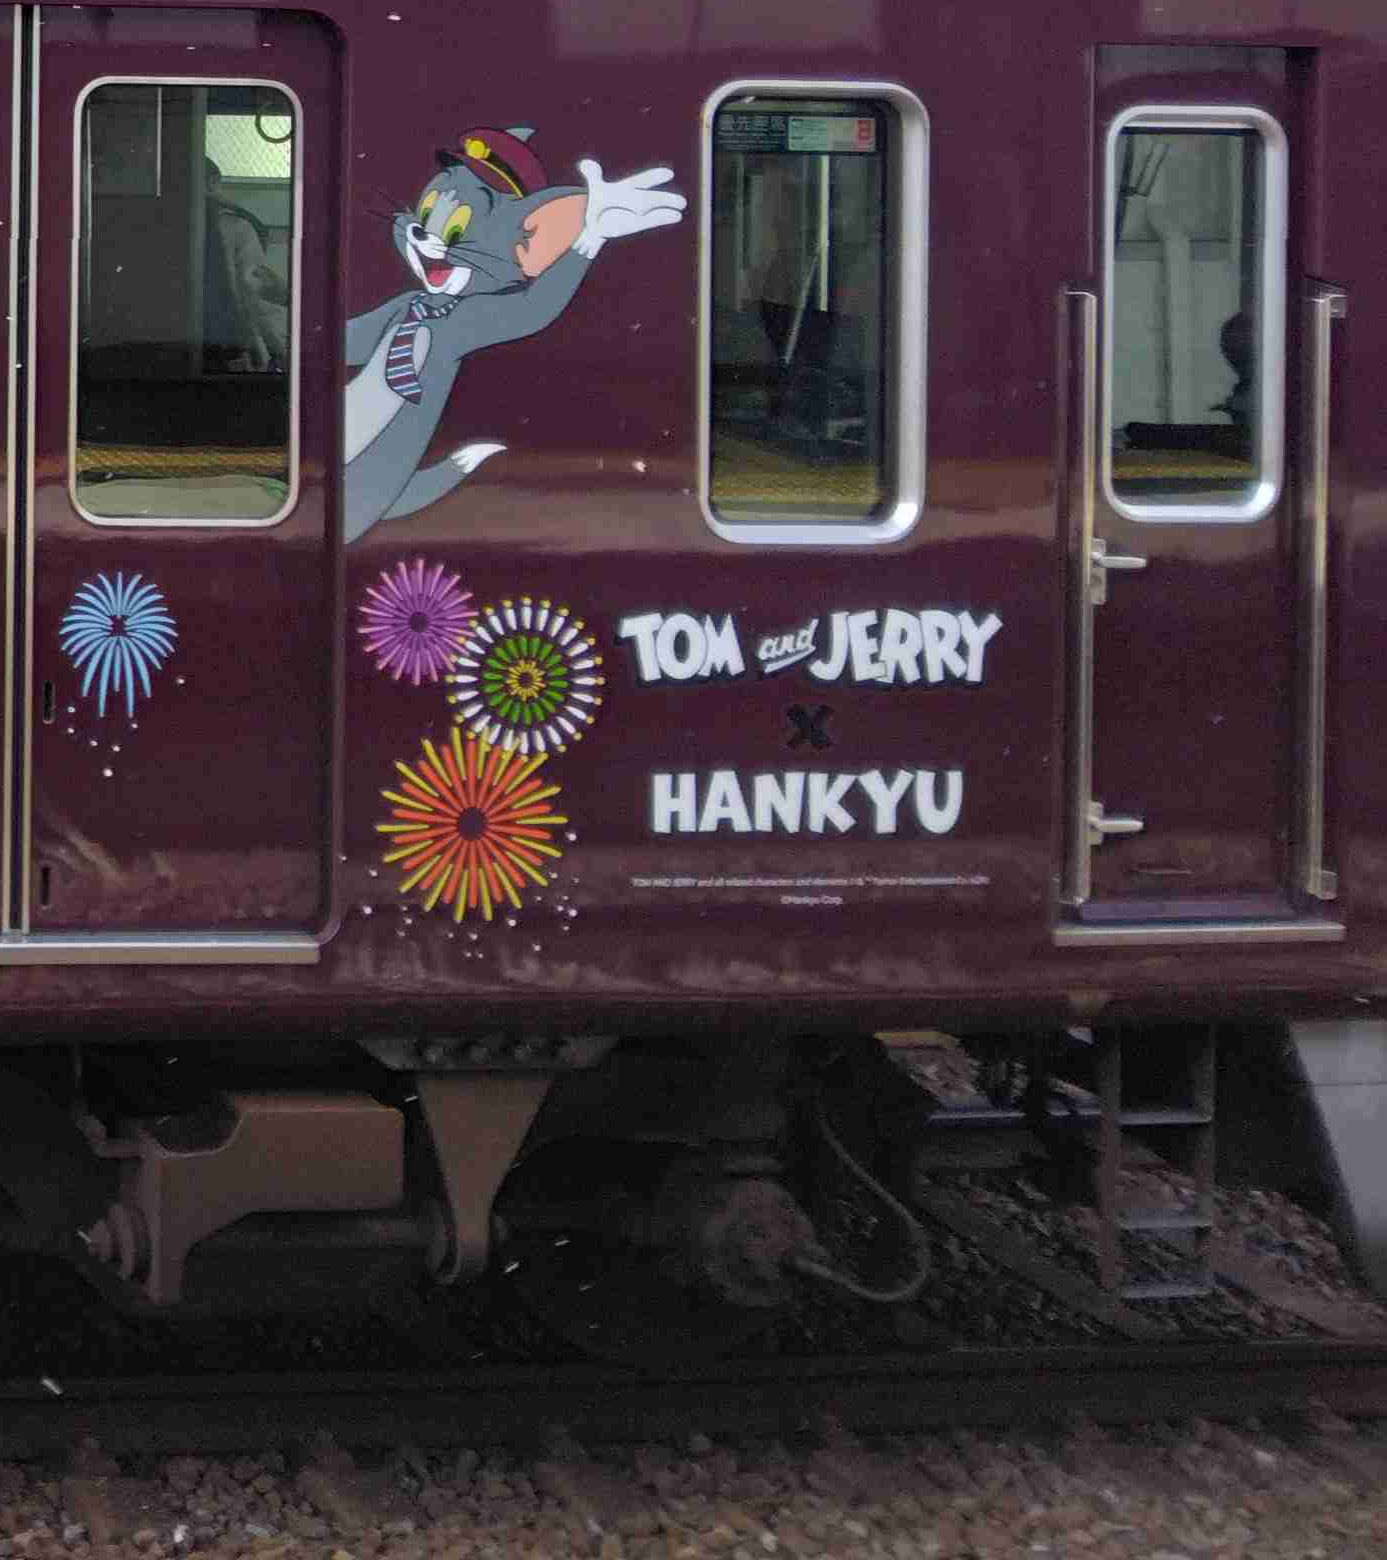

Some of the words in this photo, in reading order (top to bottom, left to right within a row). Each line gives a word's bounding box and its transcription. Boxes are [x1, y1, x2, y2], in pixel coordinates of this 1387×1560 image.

[618, 611, 746, 683] TOM
[756, 617, 820, 674] and
[808, 607, 1004, 684] JERRY
[652, 769, 964, 835] HANKYU
